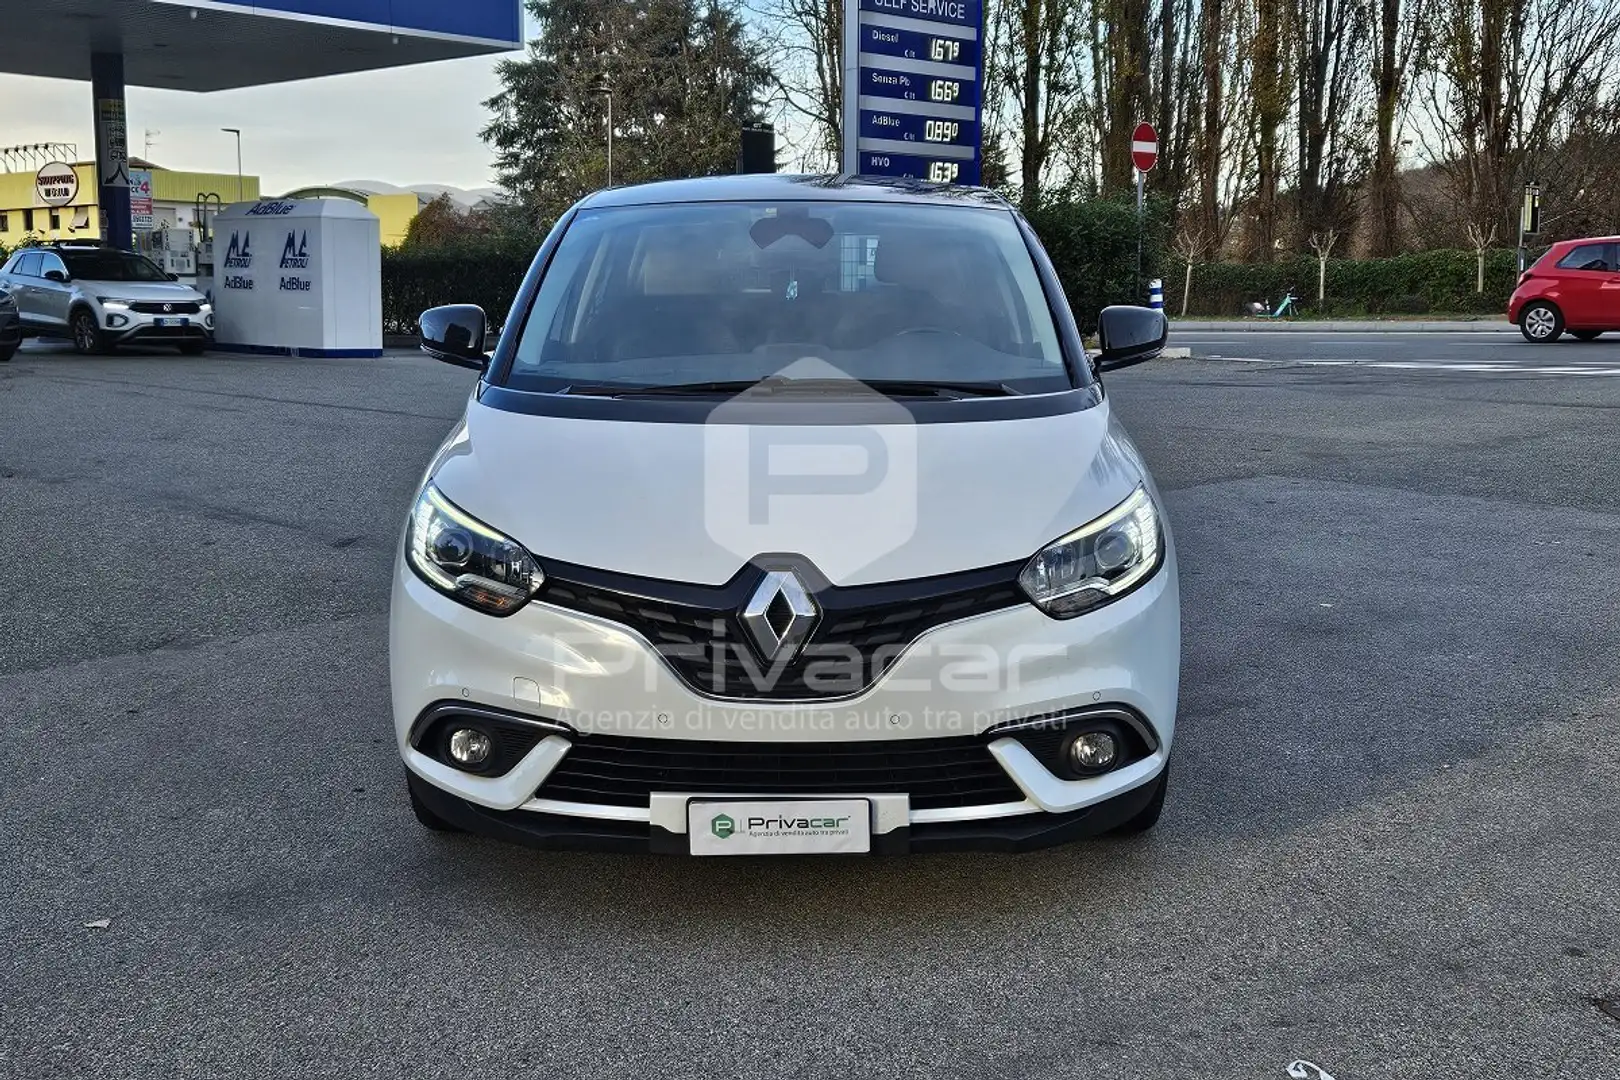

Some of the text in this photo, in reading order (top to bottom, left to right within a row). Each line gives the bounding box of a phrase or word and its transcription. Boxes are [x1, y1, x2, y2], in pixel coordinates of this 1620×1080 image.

[911, 0, 965, 19] SERVICE
[872, 30, 899, 43] Diesel
[872, 73, 911, 87] Senza Pb
[872, 115, 900, 127] AdBlue
[871, 156, 890, 167] HVO
[245, 201, 295, 216] AdBlue
[224, 275, 254, 290] AdBlue
[280, 276, 312, 291] AdBlue
[748, 815, 849, 830] Privacar
